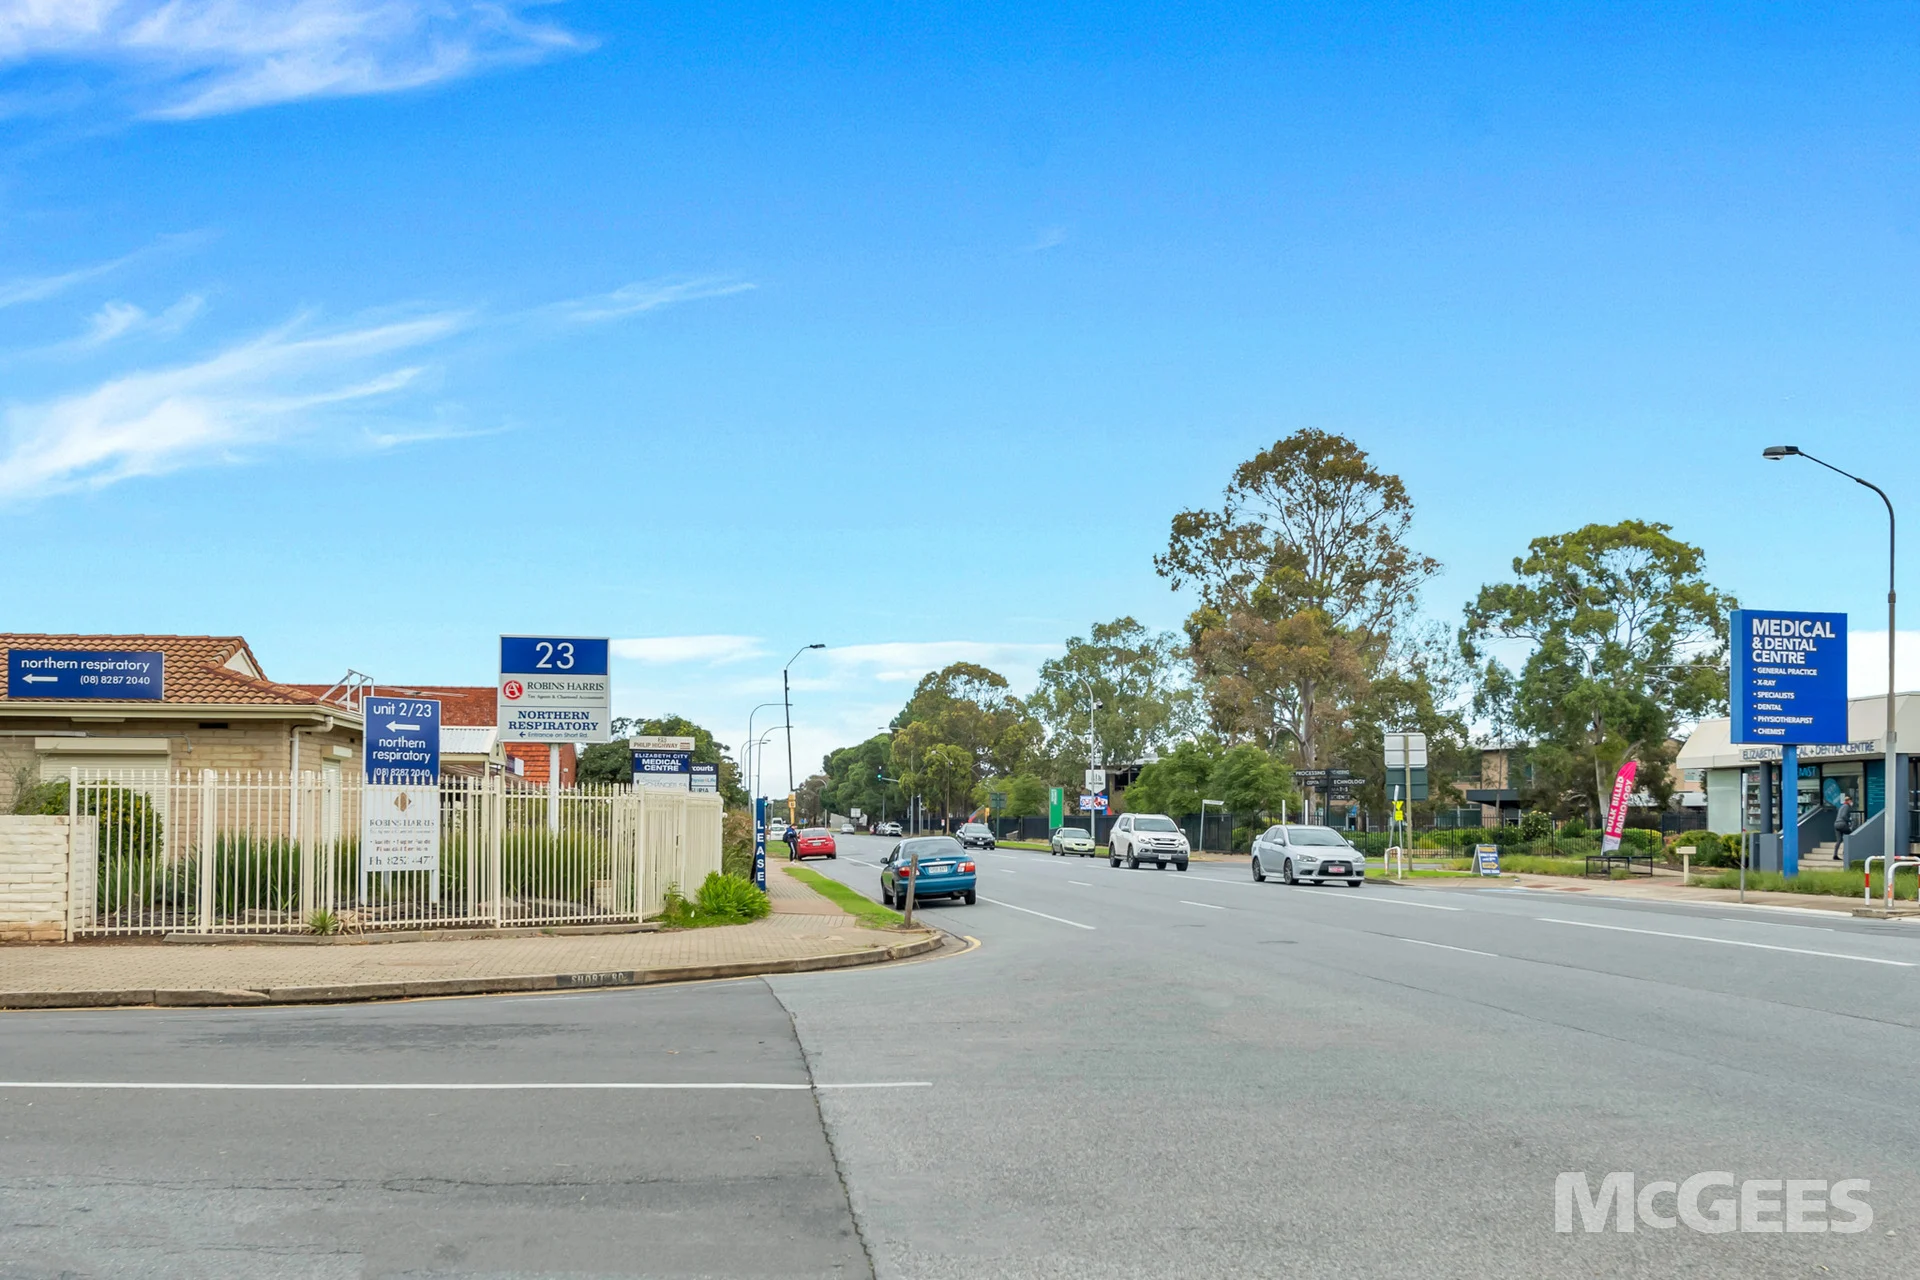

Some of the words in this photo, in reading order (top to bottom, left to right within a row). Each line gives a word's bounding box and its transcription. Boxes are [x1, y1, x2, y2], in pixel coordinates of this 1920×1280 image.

[1752, 618, 1836, 638] MEDICAL
[1751, 637, 1763, 649] &
[1764, 637, 1817, 651] DENTAL
[535, 641, 575, 669] 23
[1752, 650, 1806, 664] CENTRE
[21, 656, 78, 669] northern
[81, 658, 150, 673] respiratory
[1757, 667, 1787, 675] GENERAL
[1787, 668, 1818, 676] PRACTICE
[80, 675, 99, 686] (08)
[100, 675, 124, 685] 8287
[125, 676, 151, 685] 2040
[527, 681, 565, 691] ROBINS
[567, 682, 604, 692] HARRIS
[1757, 691, 1795, 699] SPECIALISTS
[373, 702, 396, 715] unit
[398, 702, 432, 718] 2/23
[1757, 703, 1783, 711] DENTAL
[518, 710, 590, 720] NORTHERN
[1757, 715, 1814, 724] PHYSIOTHERAPIST
[508, 721, 599, 731] RESPIRATORY
[378, 735, 426, 749] northern
[1743, 749, 1776, 760] ELIZABETH
[1816, 744, 1843, 756] DENTAL
[1845, 742, 1875, 753] CENTRE
[372, 748, 431, 764] respiratory
[641, 758, 682, 766] MEDICAL
[374, 767, 389, 778] (08)
[390, 768, 410, 777] 8287
[411, 768, 431, 778] 2040
[1611, 775, 1624, 807] BILLED
[1614, 778, 1633, 834] RADIOLOGY
[1606, 807, 1617, 833] BULK
[571, 973, 605, 984] SHORT
